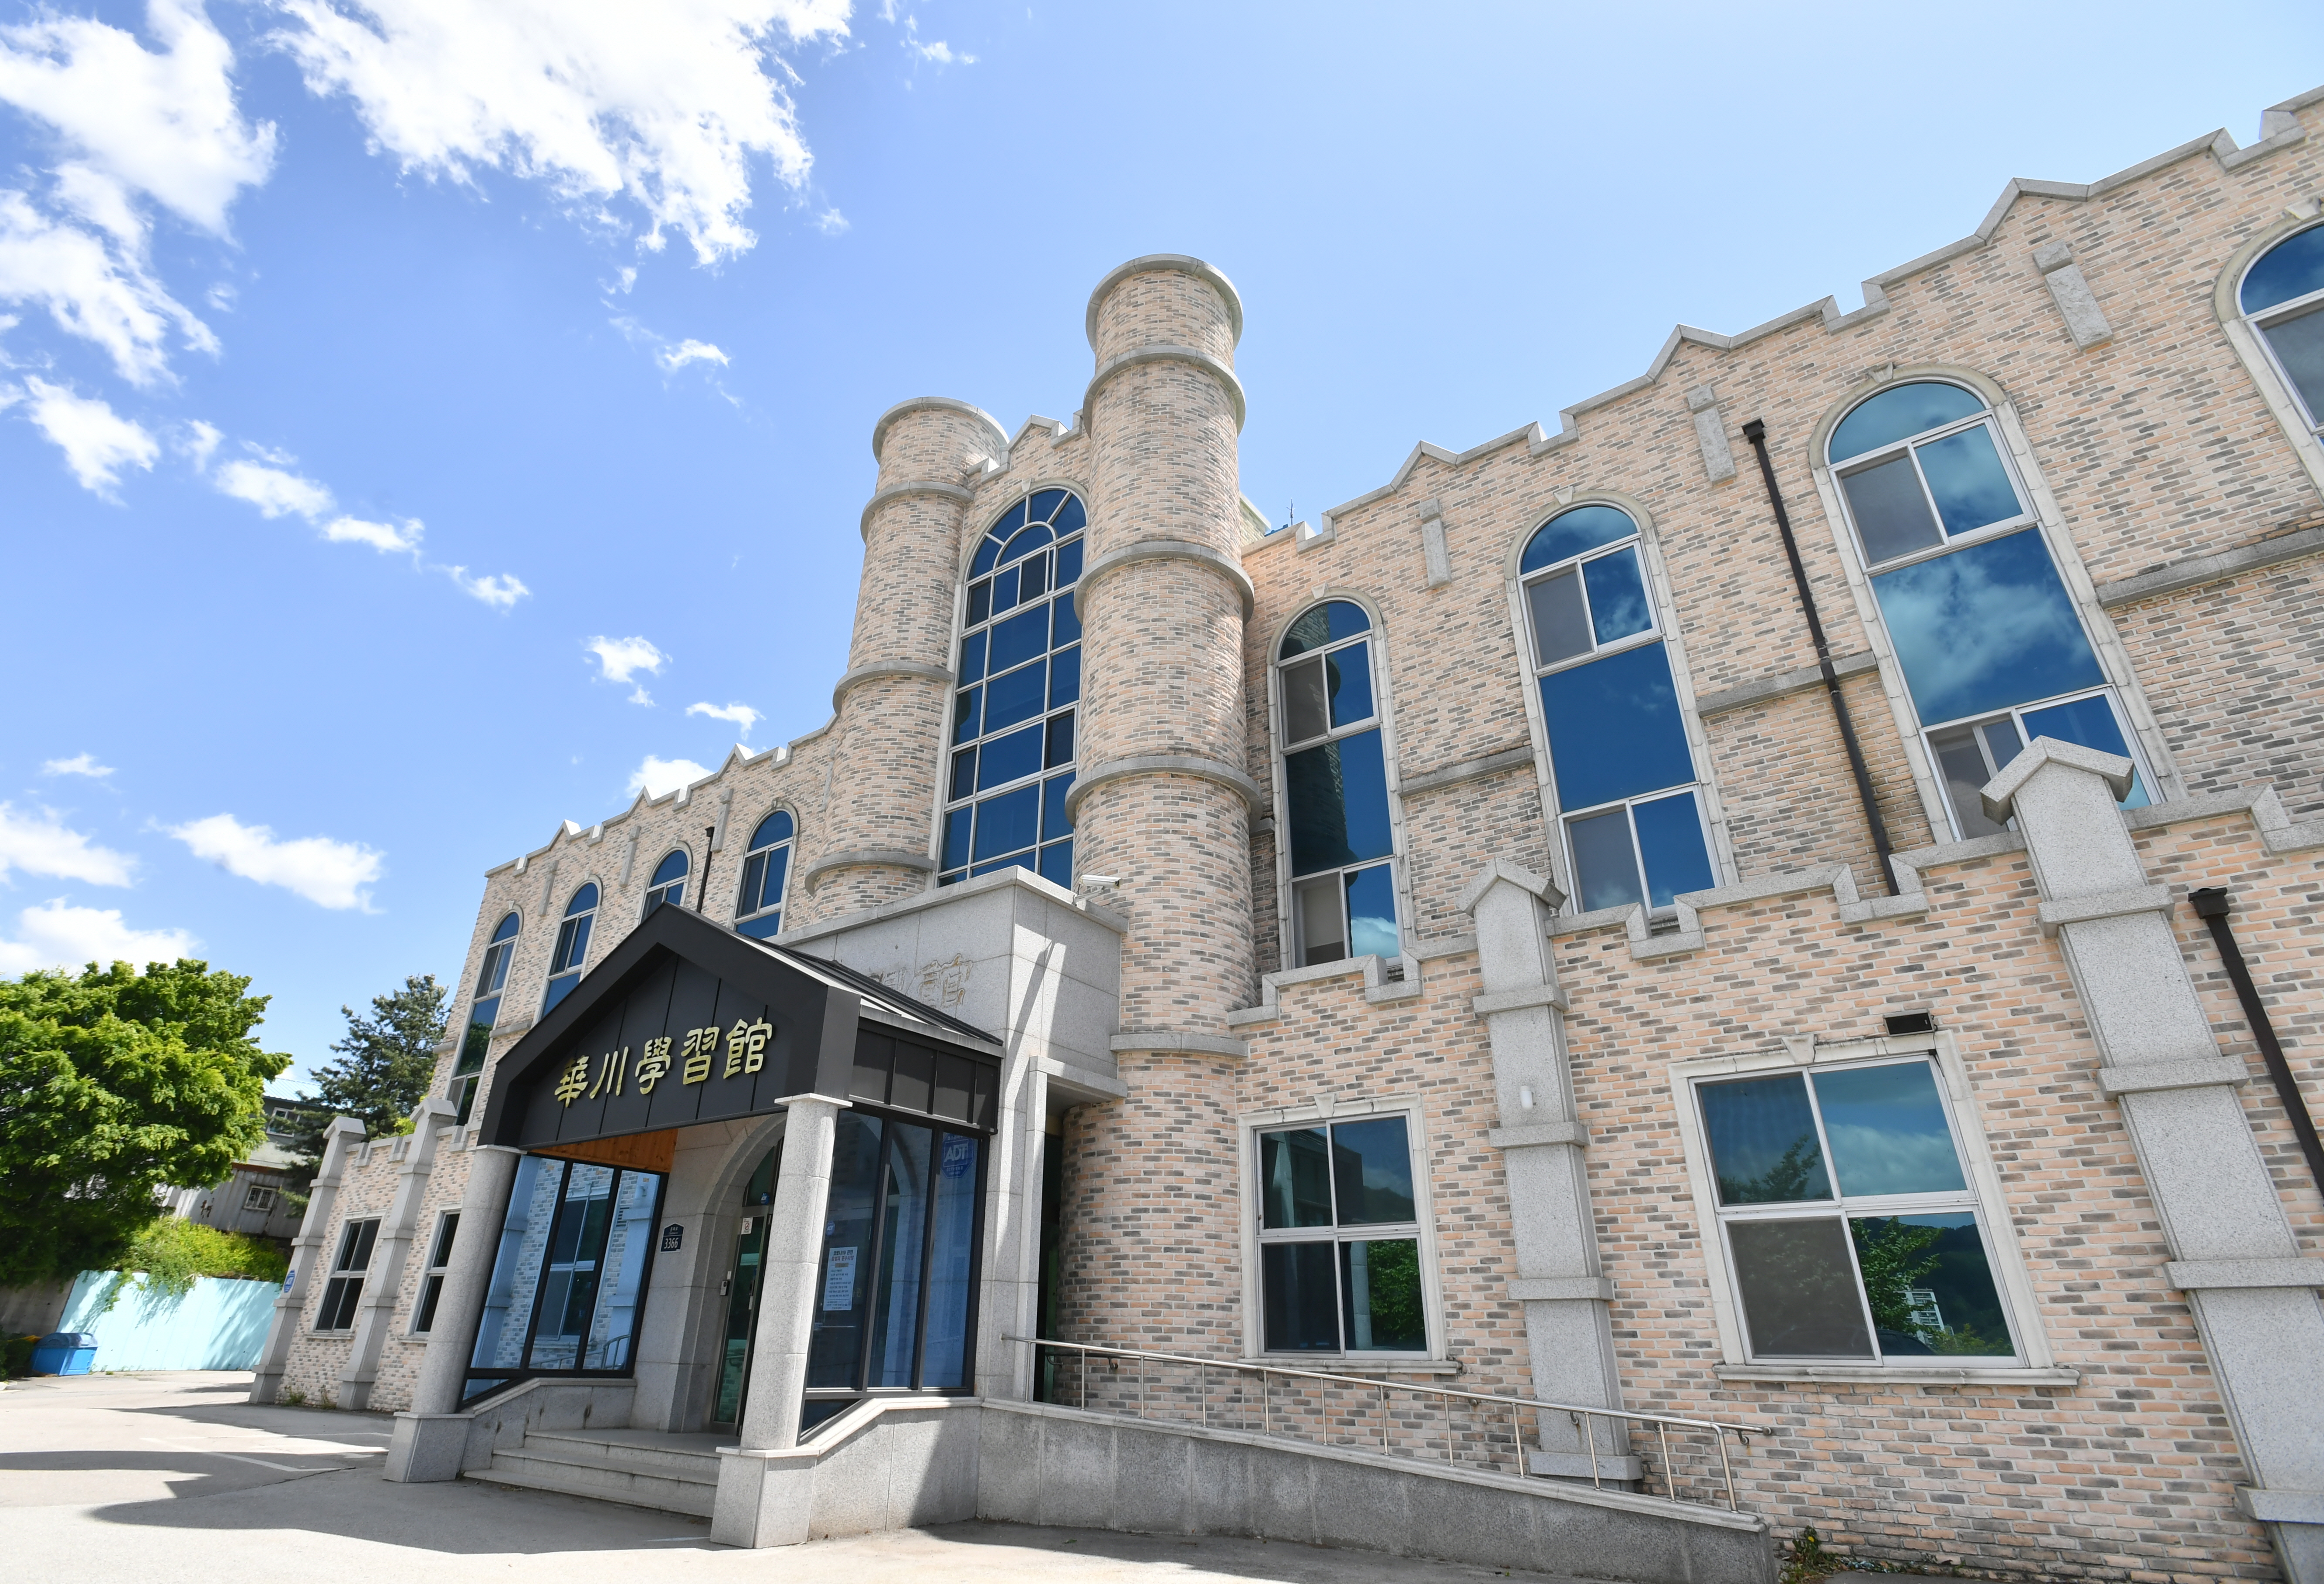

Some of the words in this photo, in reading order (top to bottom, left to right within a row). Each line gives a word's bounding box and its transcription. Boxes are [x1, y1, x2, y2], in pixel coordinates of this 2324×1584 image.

[555, 1016, 773, 1108] 華川學習館
[944, 1143, 968, 1163] ADT
[664, 1237, 679, 1249] 3366
